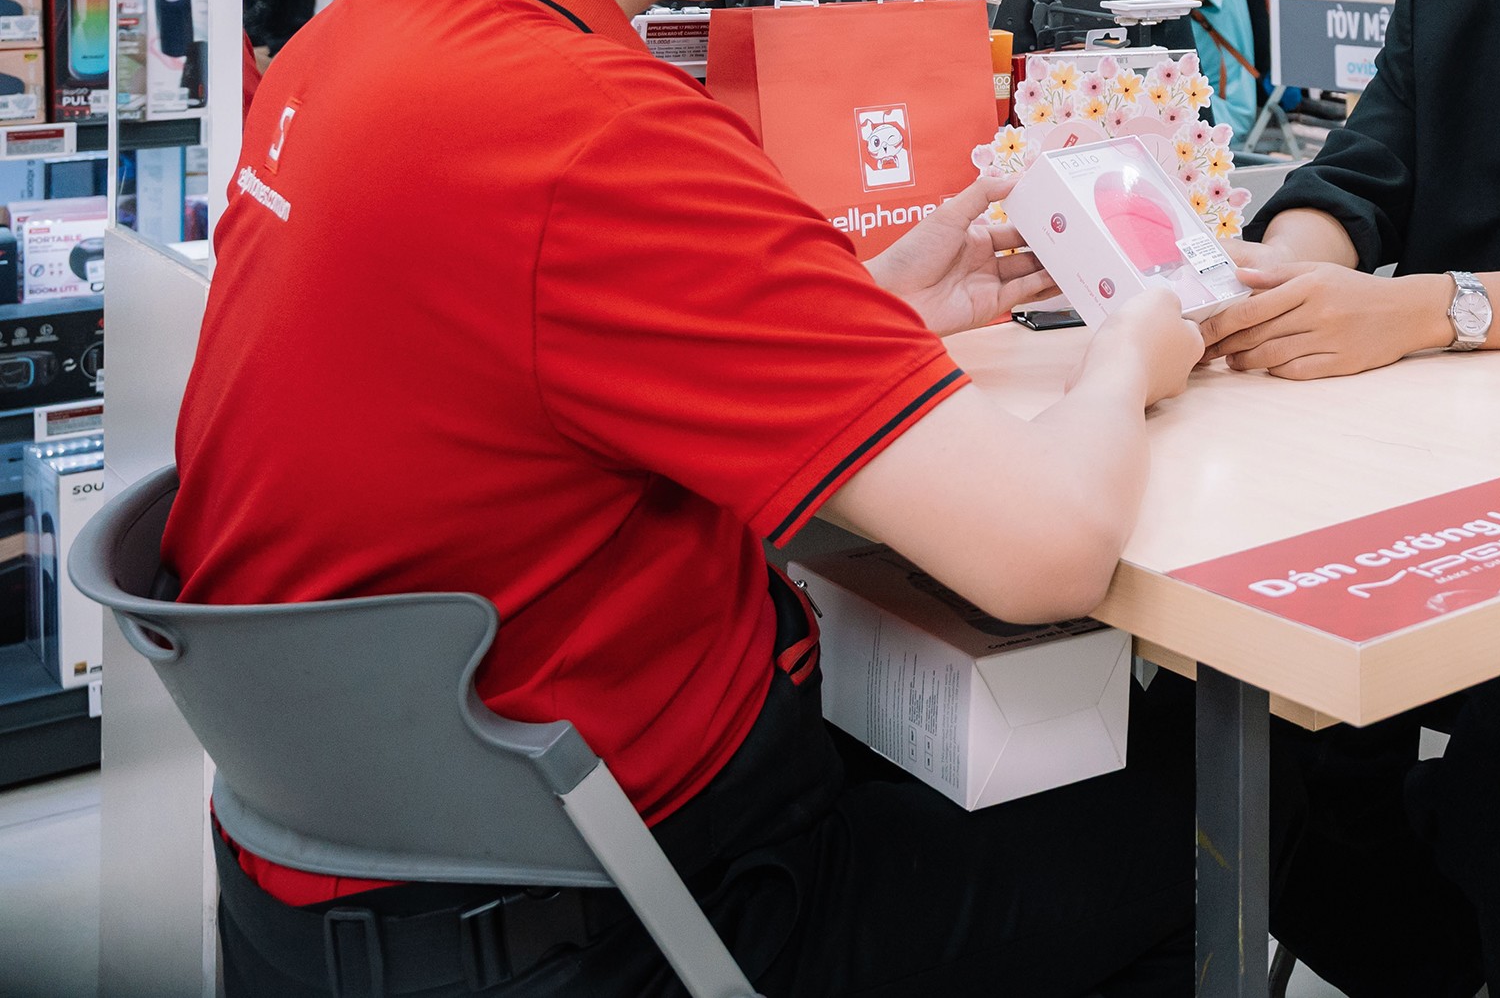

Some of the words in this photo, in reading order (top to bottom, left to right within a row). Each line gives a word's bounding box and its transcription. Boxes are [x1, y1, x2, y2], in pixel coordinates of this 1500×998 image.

[1060, 154, 1099, 170] halio
[28, 234, 81, 244] PORTABLE
[1249, 562, 1357, 598] Dán
[1434, 568, 1471, 585] MAKE
